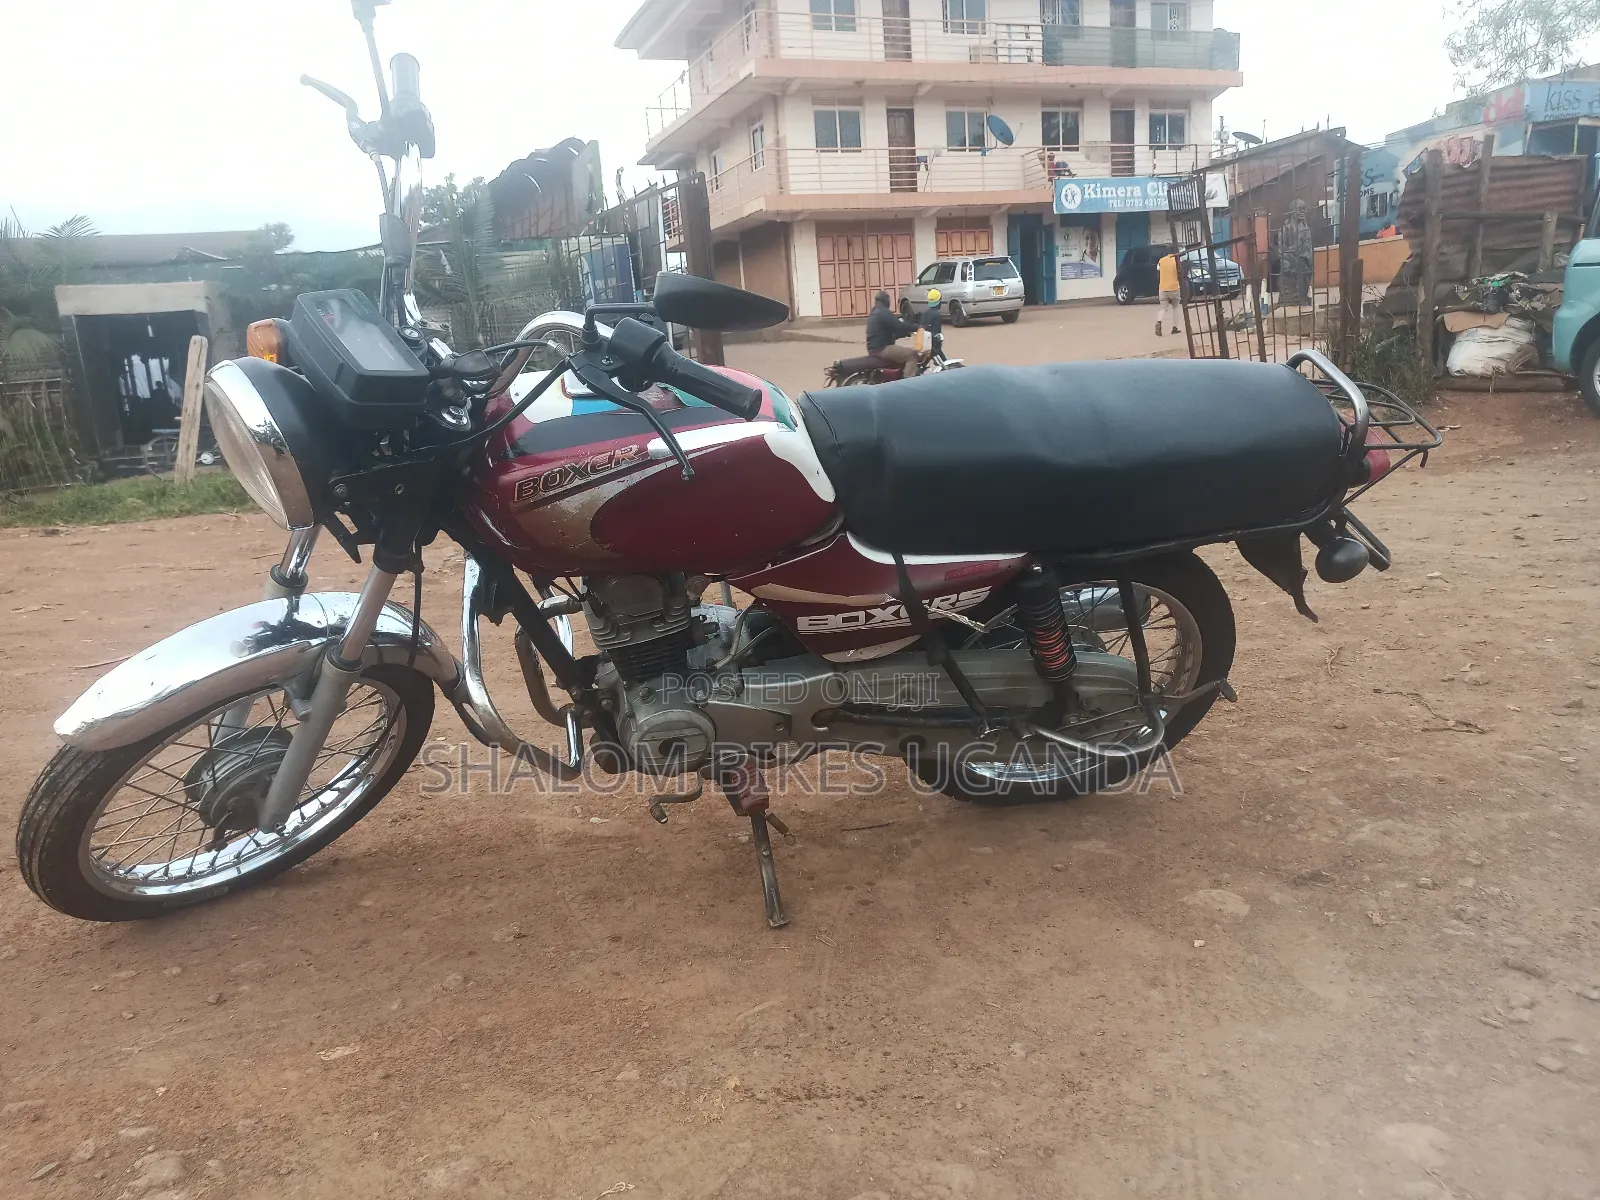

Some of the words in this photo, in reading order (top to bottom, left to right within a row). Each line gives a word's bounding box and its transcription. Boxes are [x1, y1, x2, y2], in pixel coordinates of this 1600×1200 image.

[1083, 183, 1142, 199] Kimera
[1146, 181, 1169, 197] Cli
[514, 444, 639, 502] BOXER
[797, 585, 993, 632] BOXRS
